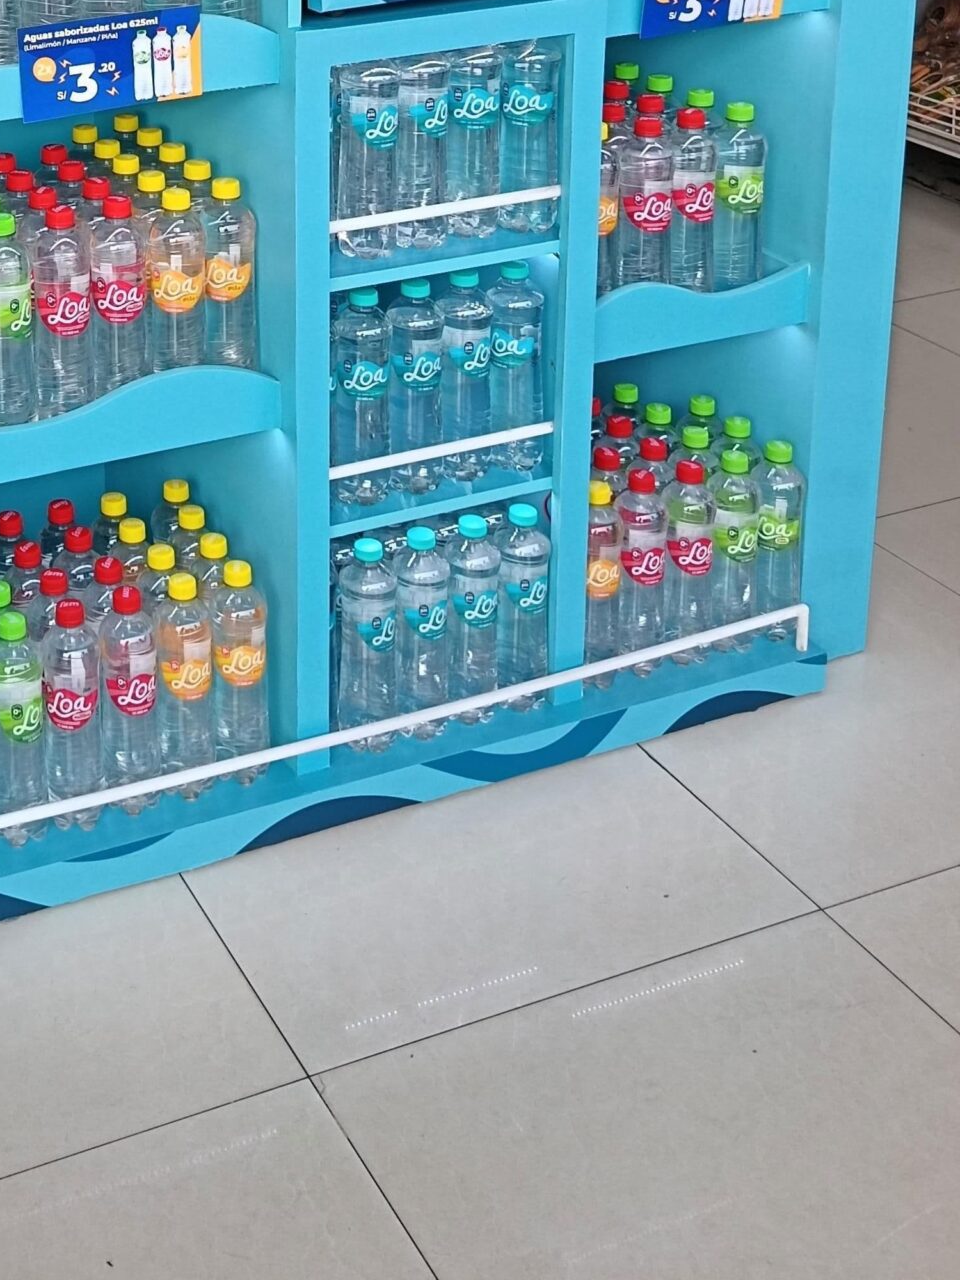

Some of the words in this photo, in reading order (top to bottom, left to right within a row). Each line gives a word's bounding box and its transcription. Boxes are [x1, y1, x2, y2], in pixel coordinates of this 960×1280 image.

[23, 32, 53, 43] Aguas
[54, 23, 110, 38] saborizadas
[111, 22, 128, 30] Loa
[129, 16, 158, 28] 625ml
[57, 90, 66, 101] S/
[453, 93, 499, 119] Loa
[503, 90, 547, 116] Loa
[425, 100, 447, 128] Lo
[633, 195, 672, 221] Loa
[685, 186, 714, 213] Lo
[154, 275, 199, 301] Loa
[205, 263, 244, 289] Loa
[48, 296, 89, 324] Loa
[97, 284, 142, 311] Loa
[464, 343, 489, 370] Lo
[343, 365, 387, 391] Loa
[727, 530, 755, 555] Lo
[519, 581, 546, 608] Lo
[419, 607, 444, 633] Lo
[222, 648, 264, 676] Loa
[48, 691, 92, 718] Loa
[13, 705, 40, 736] Lo
